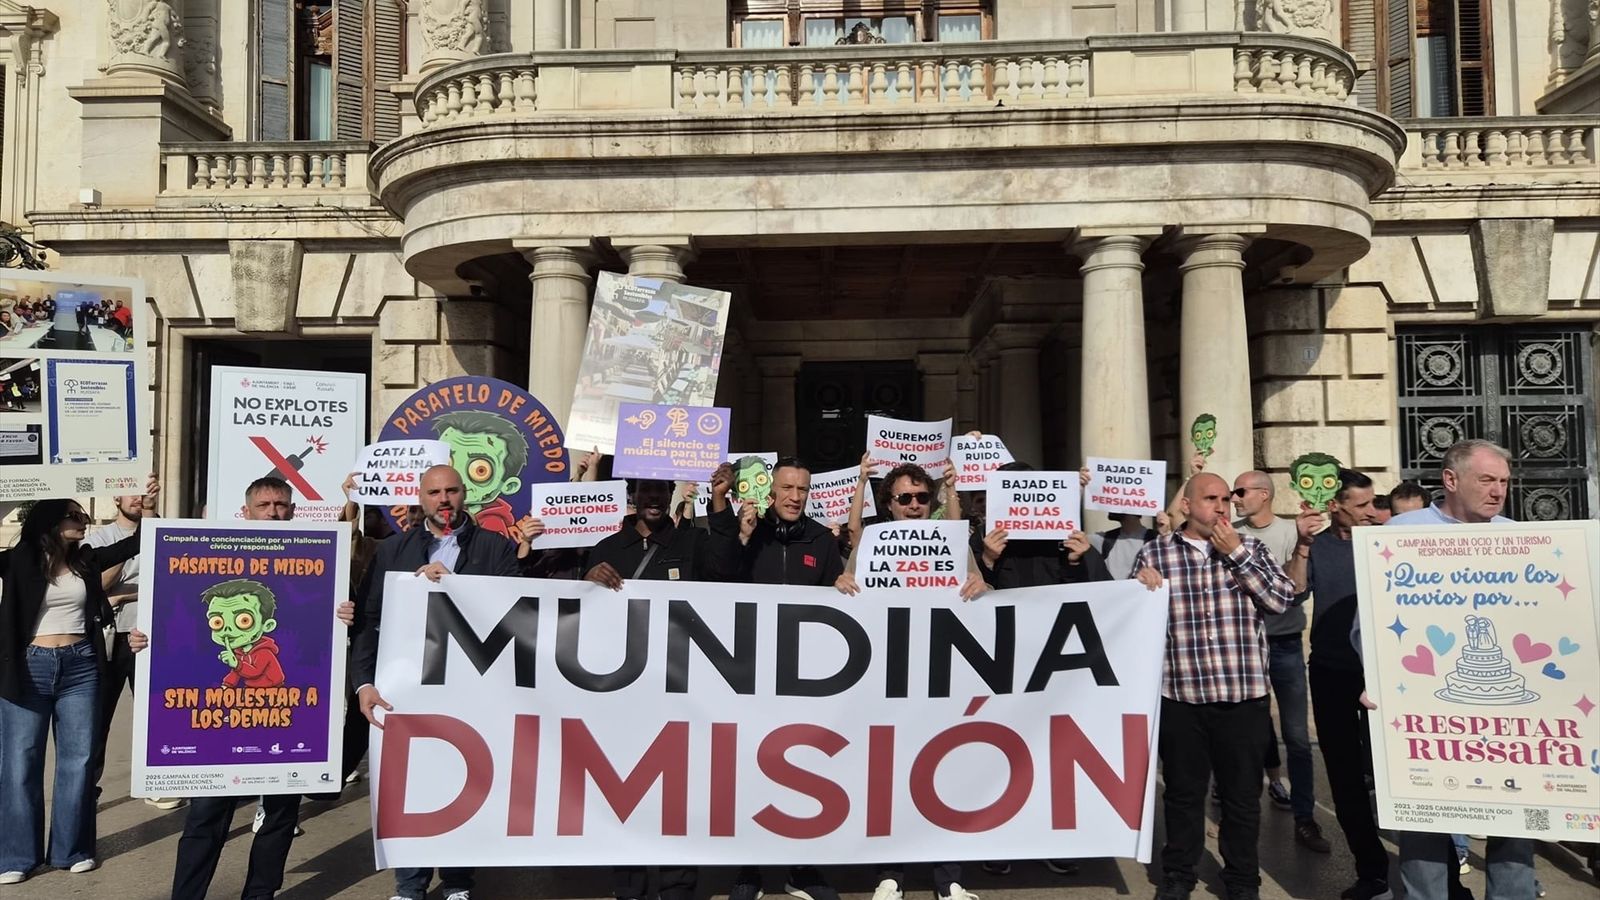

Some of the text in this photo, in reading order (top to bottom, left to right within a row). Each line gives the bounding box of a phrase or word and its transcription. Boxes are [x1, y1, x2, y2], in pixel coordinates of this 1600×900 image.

[234, 397, 348, 412] NO EXPLOTES
[234, 413, 333, 427] LAS FALLAS
[498, 389, 526, 414] DE
[524, 409, 566, 473] MIEDO
[879, 429, 942, 441] QUEREMOS
[643, 438, 653, 447] El
[657, 439, 704, 450] silencio
[875, 440, 945, 451] SOLUCIONES
[957, 441, 992, 450] BAJAD
[624, 446, 720, 460] música para tus
[900, 453, 917, 462] NO
[966, 452, 1000, 460] RUIDO
[367, 460, 433, 468] MUNDINA
[672, 458, 719, 468] vecinos
[963, 464, 979, 472] NO
[1097, 464, 1152, 475] BAJAD EL
[363, 474, 381, 482] LA
[386, 473, 414, 482] ZAS
[809, 475, 862, 490] UNTAMIENT
[955, 475, 987, 483] PERSI
[1106, 476, 1143, 485] RUIDO
[1002, 480, 1067, 489] BAJAD EL
[359, 486, 389, 496] UNA
[1103, 486, 1145, 496] NO LAS
[546, 494, 613, 505] QUEREMOS
[1013, 493, 1056, 502] RUIDO
[1092, 496, 1157, 508] PERSIANAS
[826, 499, 845, 508] ZAS
[826, 501, 870, 517] CHAPA
[541, 504, 618, 516] SOLUCIONES
[1009, 506, 1060, 516] NO LAS
[570, 517, 587, 525] NO
[995, 520, 1074, 530] PERSIANAS
[163, 535, 198, 543] Campaña
[879, 527, 947, 542] CATALÁ,
[1439, 538, 1455, 546] POR
[1457, 538, 1469, 546] UN
[1472, 538, 1491, 546] OCIO
[1495, 537, 1499, 545] Y
[1502, 537, 1514, 545] UN
[1516, 536, 1551, 545] TURISMO
[873, 545, 951, 556] MUNDINA
[1419, 547, 1530, 556] RESPONSABLE Y DE CALIDAD
[169, 553, 324, 576] PÁSATELO DE MIEDO
[870, 561, 954, 572] LA ZAS ES
[1451, 566, 1517, 583] vivan
[1525, 563, 1559, 583] los
[865, 576, 958, 588] UNA RUINA
[1396, 590, 1467, 606] novios
[420, 591, 1120, 699] MUNDINA
[165, 688, 317, 708] SIN MOLESTAR A
[191, 709, 223, 729] LOS
[1403, 714, 1583, 739] RESPETAR
[376, 696, 1149, 839] DIMISIÓN
[1442, 812, 1490, 820] RESPONSABLE
